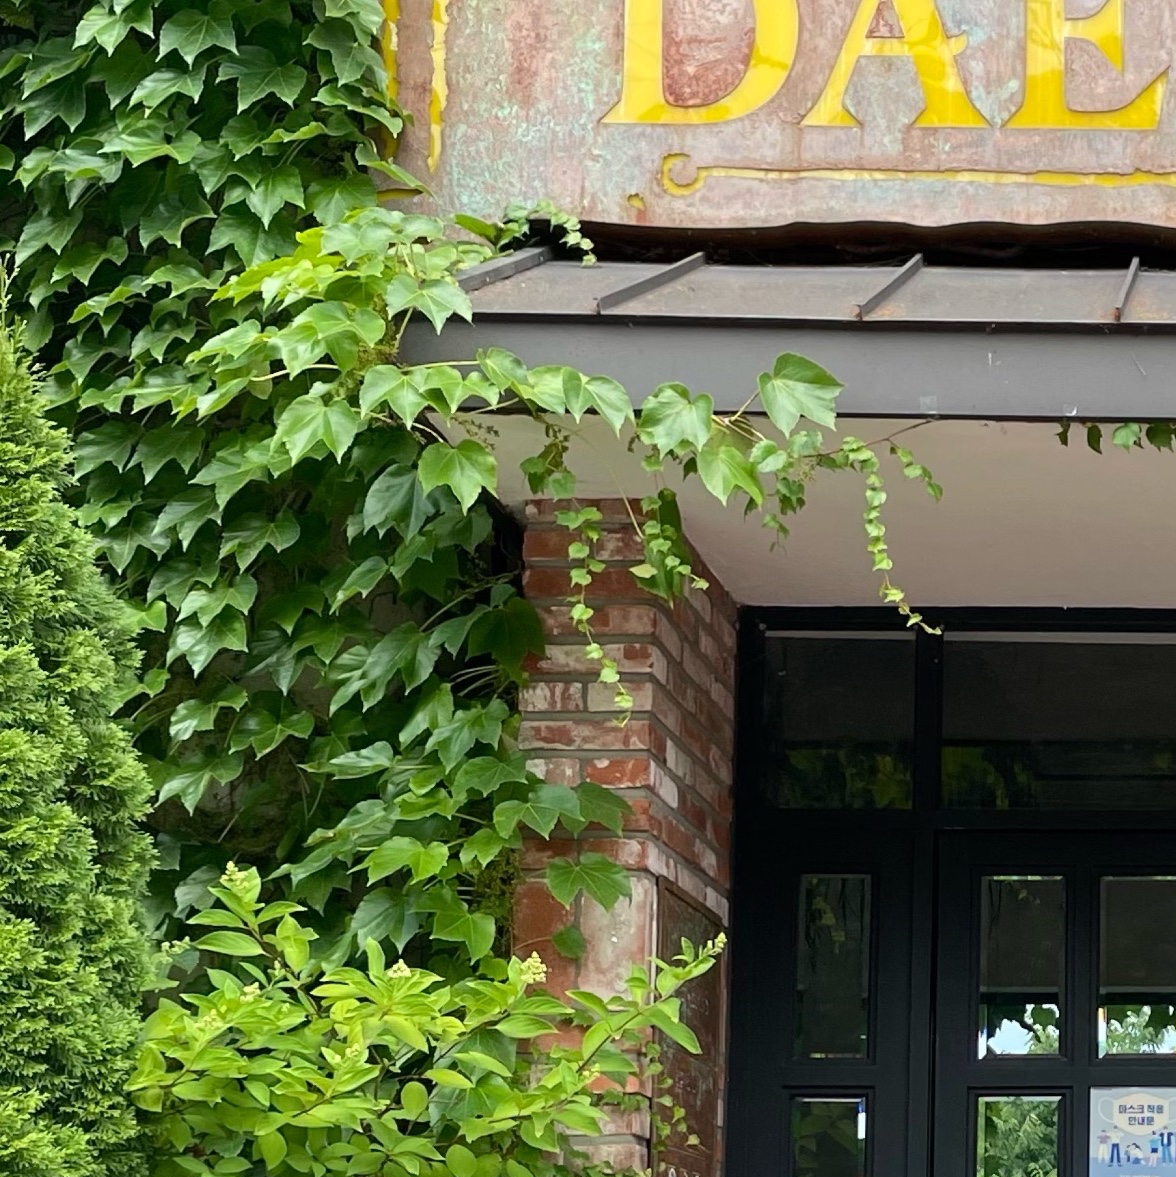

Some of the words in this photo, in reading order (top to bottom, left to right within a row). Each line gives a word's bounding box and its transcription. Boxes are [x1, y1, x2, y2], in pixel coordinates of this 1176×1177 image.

[1118, 1104, 1145, 1114] 마스크
[1147, 1104, 1164, 1114] 착용
[1128, 1116, 1155, 1126] 안내문
